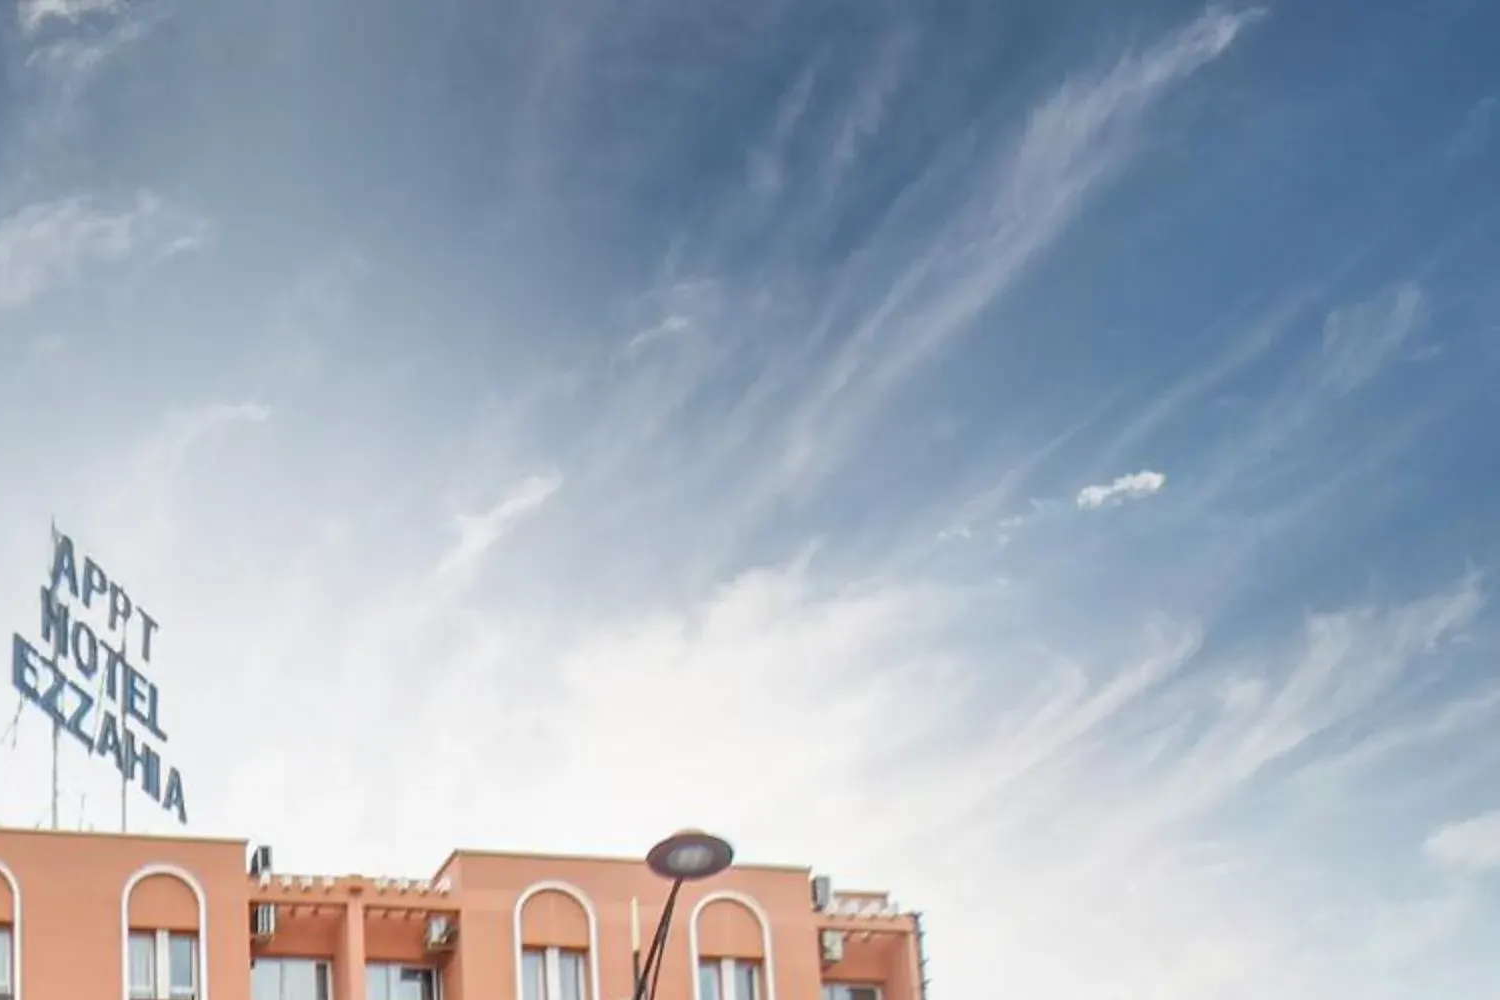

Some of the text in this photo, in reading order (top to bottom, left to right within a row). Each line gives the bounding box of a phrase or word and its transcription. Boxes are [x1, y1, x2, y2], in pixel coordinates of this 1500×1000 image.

[41, 585, 168, 742] HOTEL
[51, 535, 159, 662] APPT
[12, 632, 188, 824] EZZAHIA
